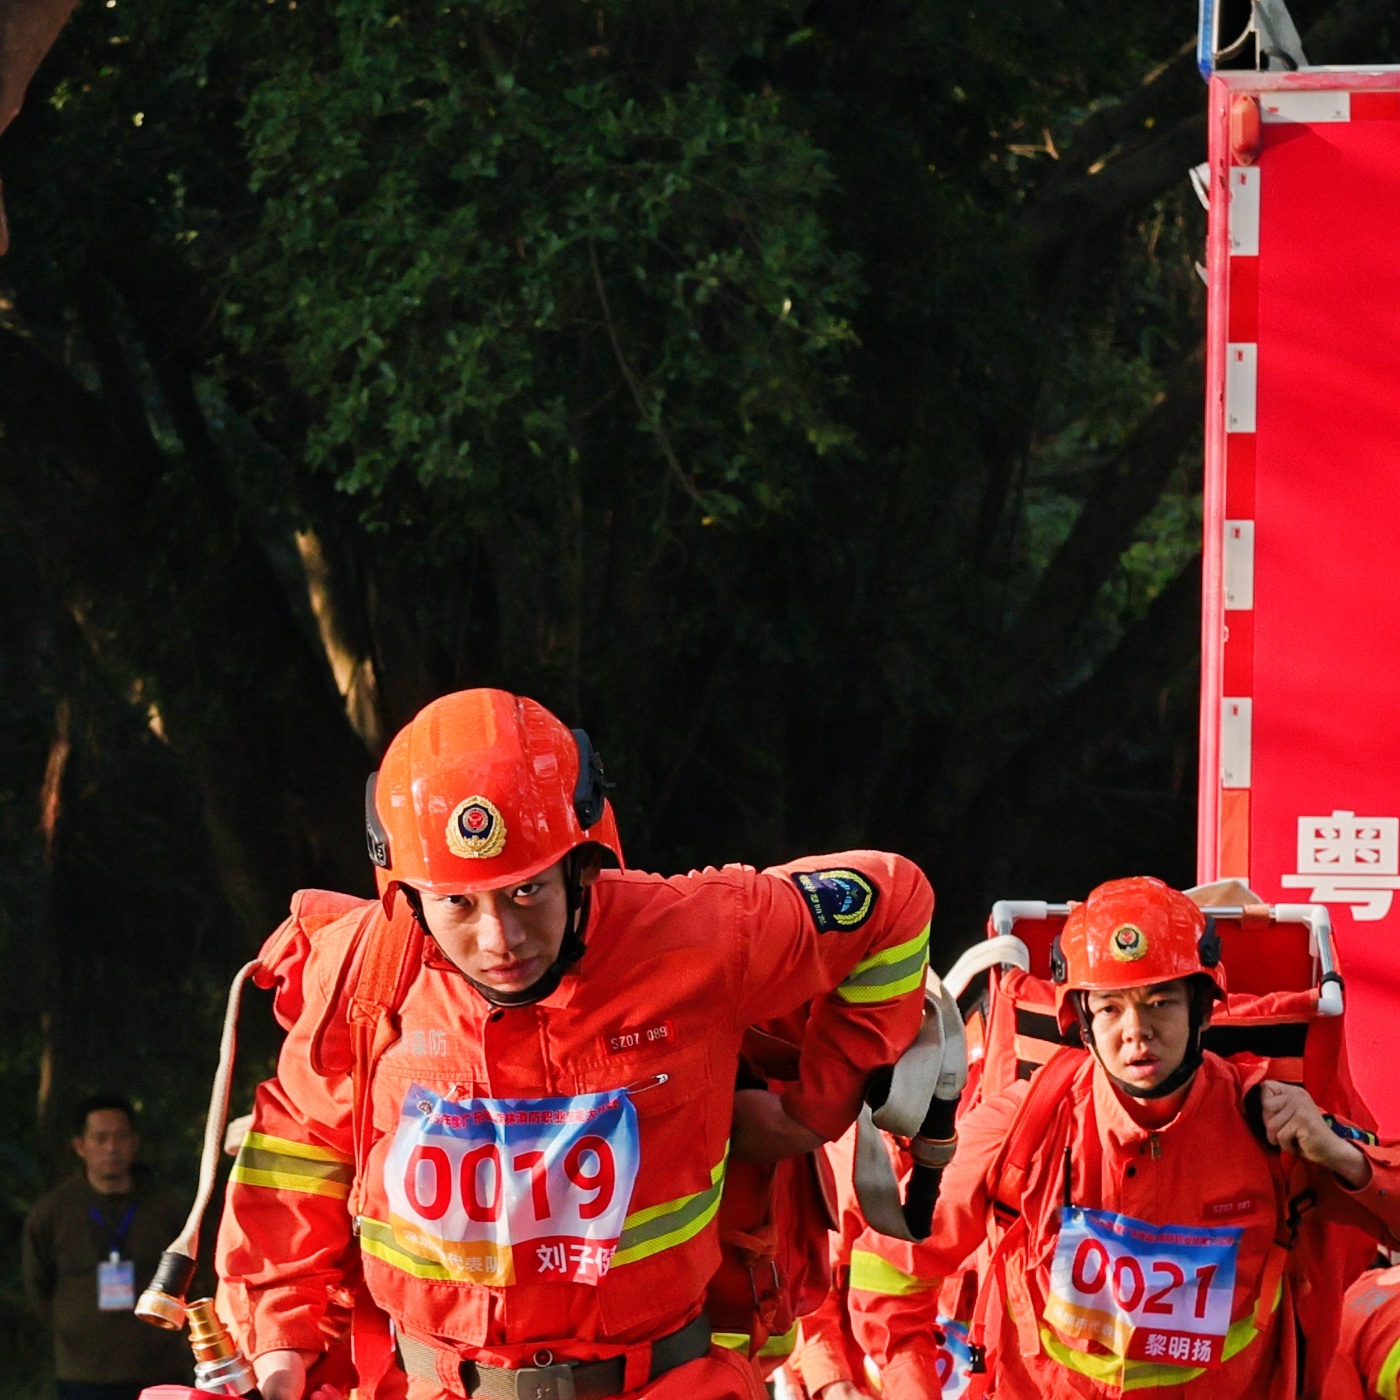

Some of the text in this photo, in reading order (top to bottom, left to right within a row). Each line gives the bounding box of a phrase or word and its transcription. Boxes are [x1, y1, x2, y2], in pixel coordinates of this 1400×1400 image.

[610, 1032, 640, 1050] SZ07
[404, 1134, 616, 1223] 0019
[1071, 1237, 1219, 1319] 0021
[1145, 1333, 1212, 1363] 黎明扬
